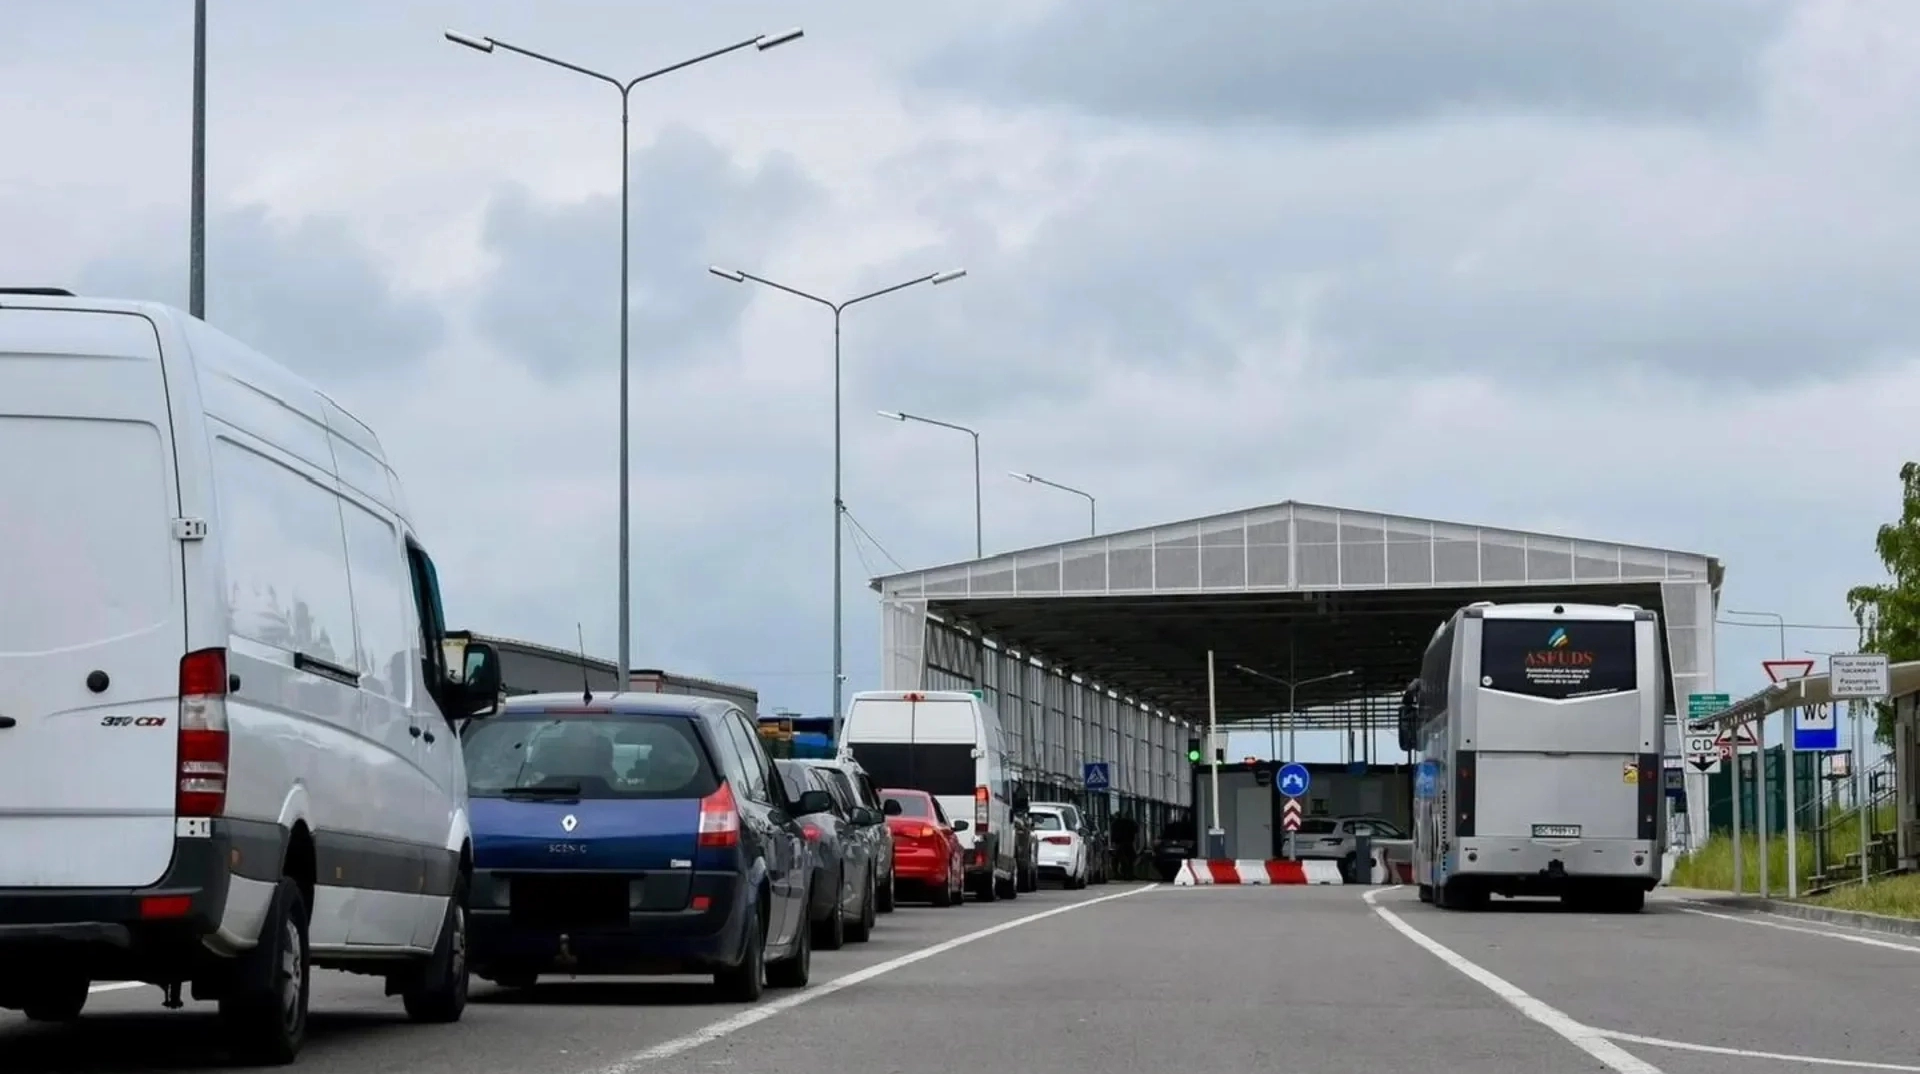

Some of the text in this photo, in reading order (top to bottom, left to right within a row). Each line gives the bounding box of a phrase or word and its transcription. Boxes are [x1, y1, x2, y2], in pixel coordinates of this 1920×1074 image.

[1525, 651, 1594, 666] ASFUDS
[1803, 702, 1828, 720] WC
[134, 716, 166, 727] CDI
